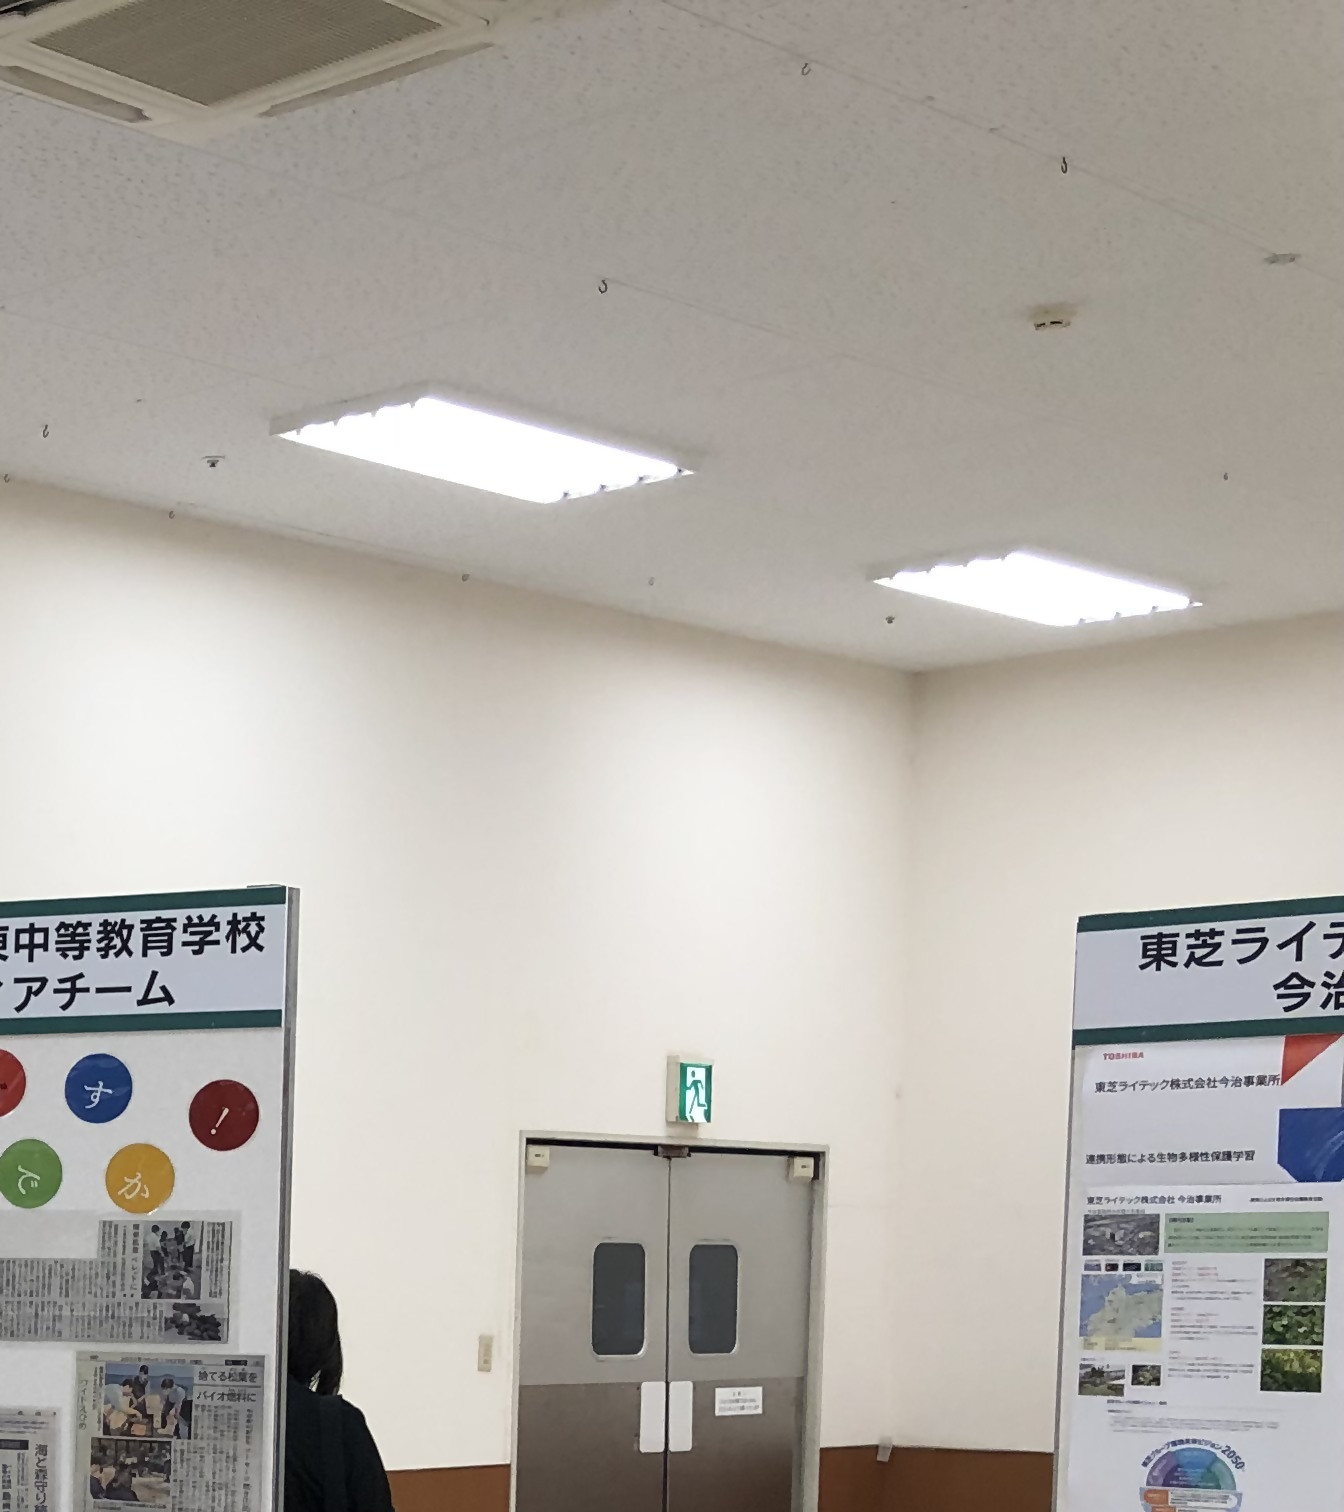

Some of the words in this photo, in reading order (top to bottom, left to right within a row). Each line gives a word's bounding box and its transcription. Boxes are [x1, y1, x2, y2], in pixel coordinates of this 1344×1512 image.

[1103, 1052, 1144, 1061] TOSHIBA
[1095, 1074, 1281, 1093] 東芝ライテック株式会社今治事業所
[1221, 1445, 1246, 1469] 2050
